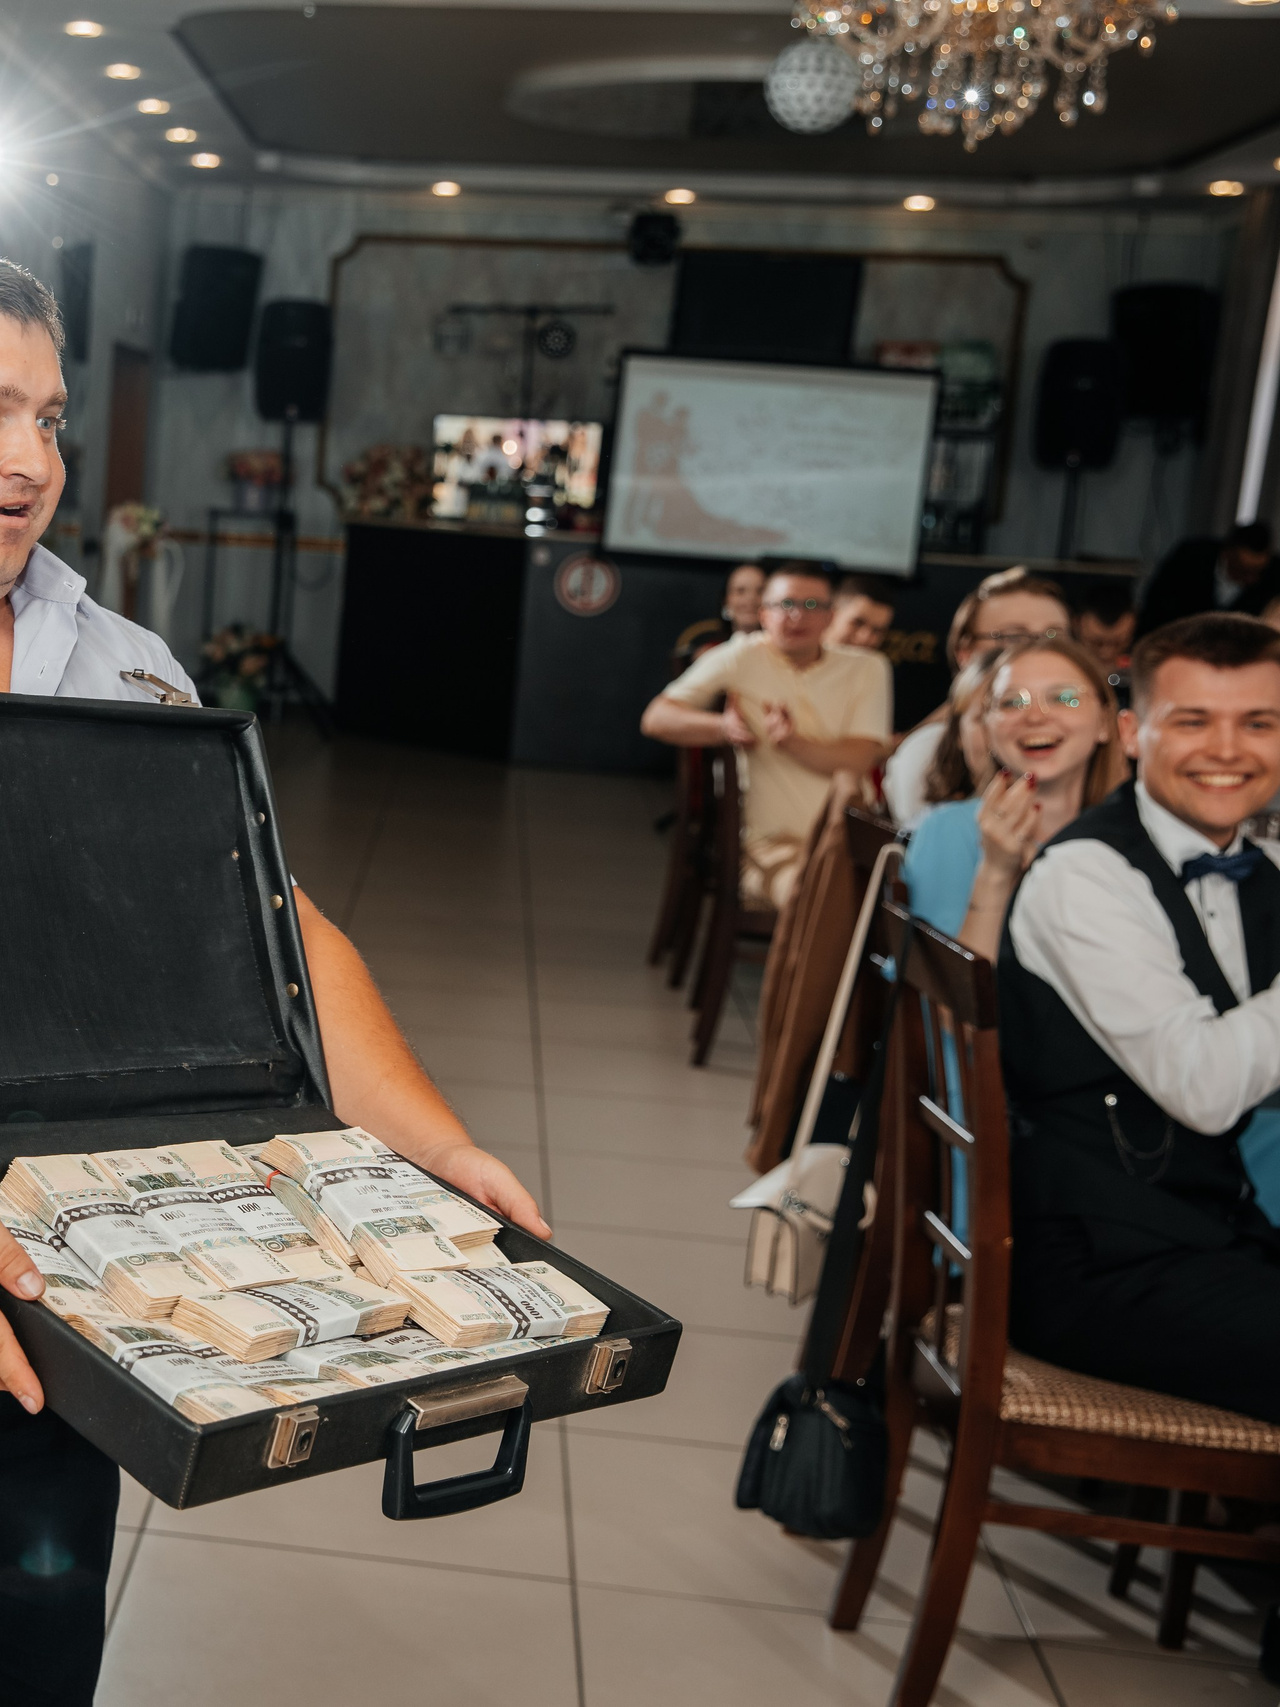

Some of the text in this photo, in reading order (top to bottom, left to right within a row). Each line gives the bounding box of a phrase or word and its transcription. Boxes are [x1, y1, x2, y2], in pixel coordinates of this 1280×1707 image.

[354, 1184, 380, 1196] 1000
[237, 1202, 262, 1214] 1000
[160, 1210, 186, 1221] 1000
[111, 1219, 136, 1229] 1000
[370, 1217, 400, 1238] 10
[293, 1296, 320, 1311] 1000
[520, 1300, 544, 1320] 1000
[384, 1334, 411, 1346] 1000
[167, 1357, 196, 1367] 1000
[216, 1358, 243, 1368] 1000
